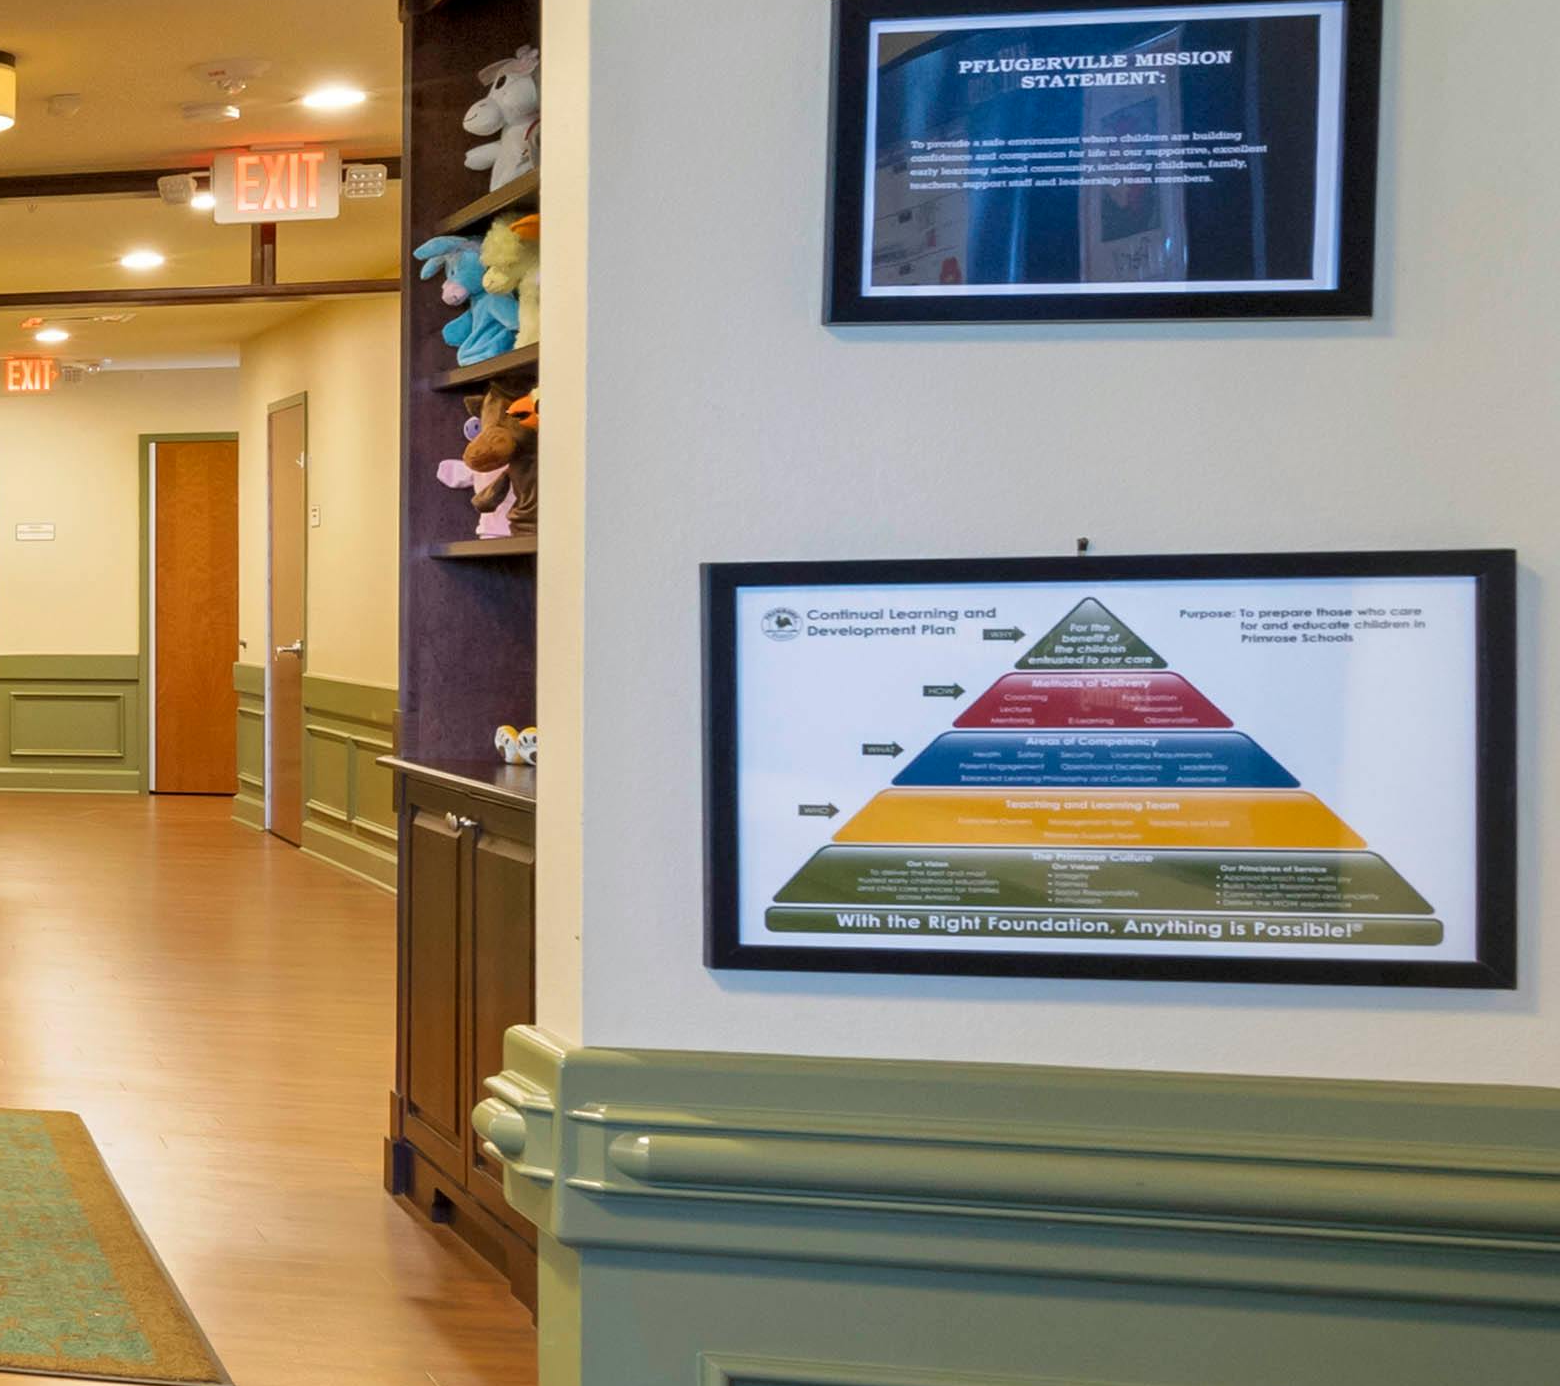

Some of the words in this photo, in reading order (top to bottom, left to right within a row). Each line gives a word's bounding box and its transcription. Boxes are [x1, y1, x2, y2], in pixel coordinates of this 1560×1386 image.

[958, 55, 1127, 74] PFLUGERVILLE
[1135, 50, 1232, 67] MISSION
[1021, 71, 1166, 88] STATEMENT:
[910, 140, 924, 149] To
[926, 139, 970, 150] provide
[980, 137, 1005, 147] safe
[1008, 137, 1080, 146] environment
[1082, 135, 1117, 144] where
[1120, 132, 1169, 143] children
[1171, 134, 1190, 142] are
[1192, 131, 1242, 142] building
[234, 152, 324, 212] EXIT
[8, 359, 53, 391] EXIT
[806, 608, 884, 621] Continual
[889, 608, 959, 622] Learning
[964, 608, 997, 619] and
[1179, 609, 1236, 620] Purpose:
[1240, 608, 1254, 618] To
[1258, 609, 1312, 620] prepare
[1316, 607, 1352, 617] those
[1358, 607, 1386, 617] who
[1390, 607, 1422, 617] care
[807, 625, 916, 638] Development
[921, 624, 956, 636] Plan
[1070, 623, 1088, 632] For
[1090, 623, 1111, 632] the
[1241, 620, 1257, 630] for
[1262, 620, 1289, 630] and
[1293, 620, 1350, 630] educate
[1354, 619, 1410, 629] children
[1414, 619, 1426, 629] in
[1061, 633, 1104, 643] benefit
[1106, 633, 1120, 643] of
[1241, 633, 1297, 644] Primrose
[1301, 633, 1353, 643] Schools
[1054, 644, 1074, 653] the
[1077, 644, 1126, 653] children
[1028, 655, 1084, 664] entrusted
[1087, 655, 1100, 664] to
[1102, 656, 1121, 664] our
[1124, 656, 1154, 664] care
[927, 687, 955, 695] HOW
[1026, 737, 1061, 746] Areas
[1063, 737, 1075, 746] of
[1078, 737, 1159, 747] Competency
[836, 914, 881, 929] With
[887, 915, 921, 929] the
[928, 915, 981, 934] Right
[988, 916, 1117, 935] Foundation,
[1123, 919, 1223, 938] Anything
[1229, 921, 1246, 936] is
